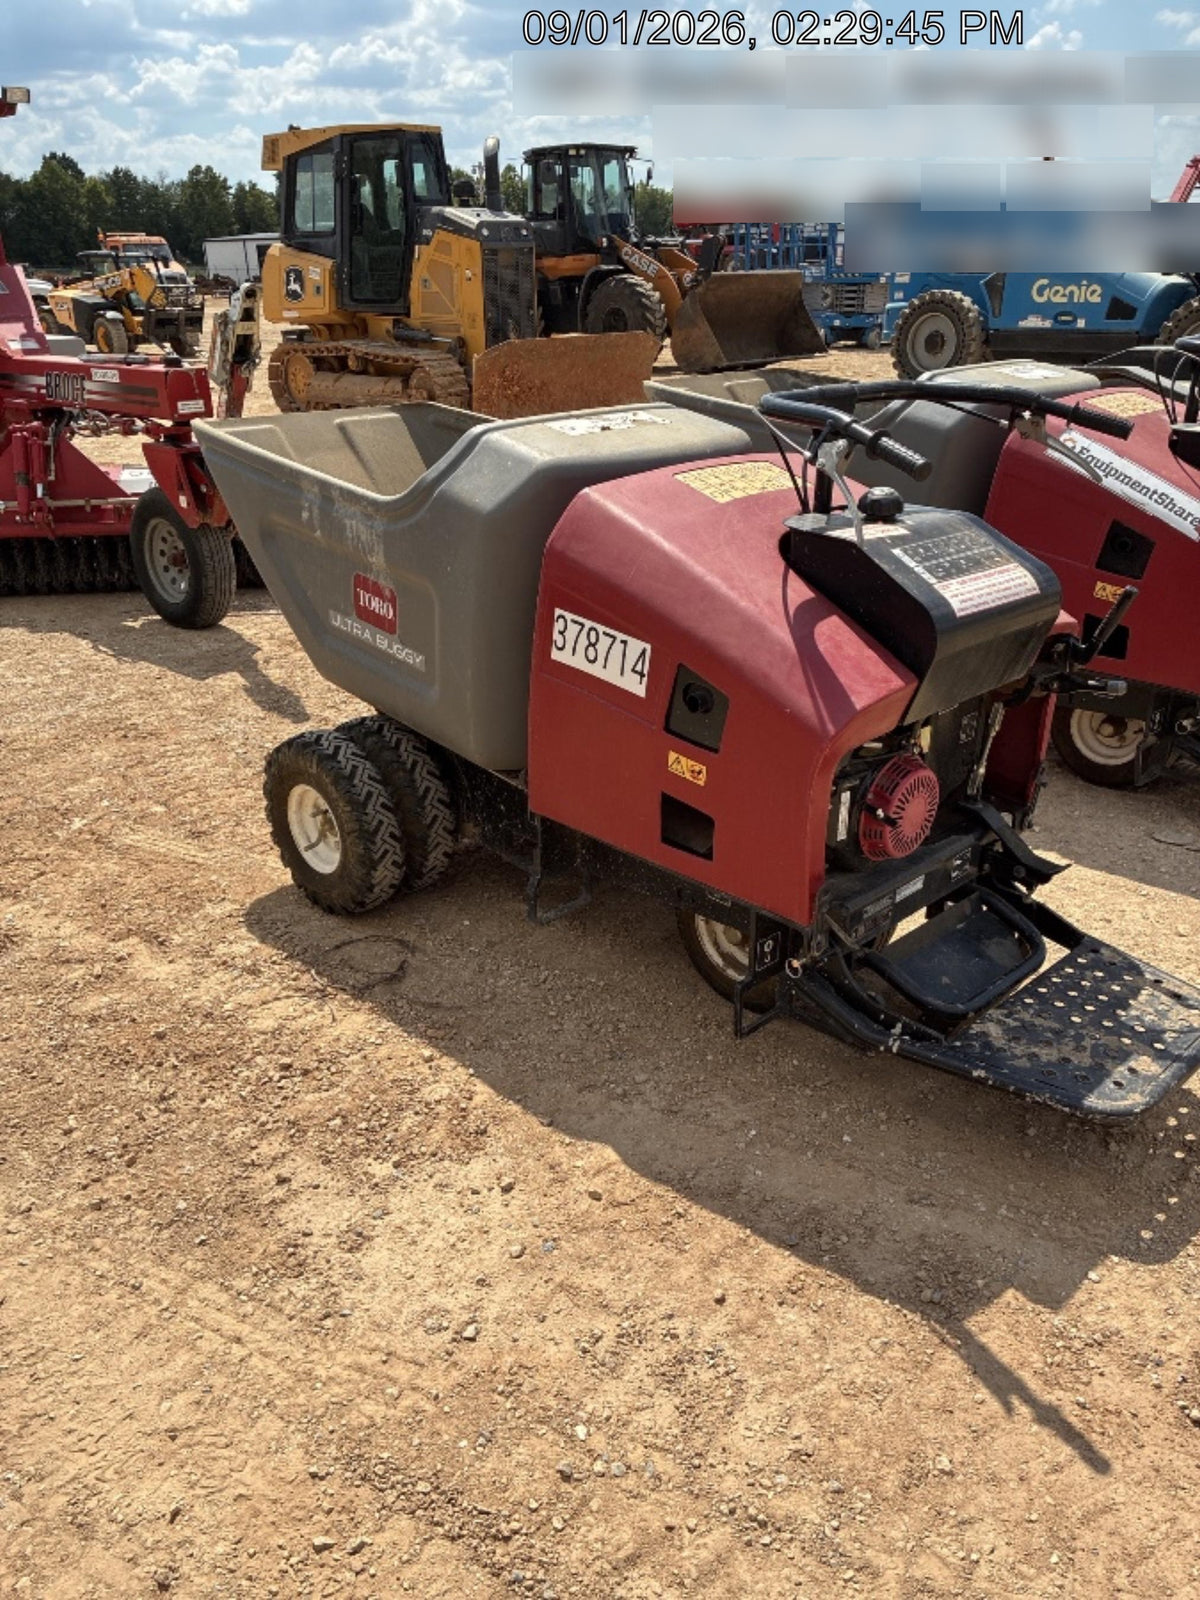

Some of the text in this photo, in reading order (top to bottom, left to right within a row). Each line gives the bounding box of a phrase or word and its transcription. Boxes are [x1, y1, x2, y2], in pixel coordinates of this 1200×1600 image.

[621, 246, 659, 278] CASE
[1031, 278, 1103, 303] Genie
[356, 587, 395, 621] TORO
[330, 613, 422, 664] ULTRA BUGGY
[554, 613, 648, 685] 378714
